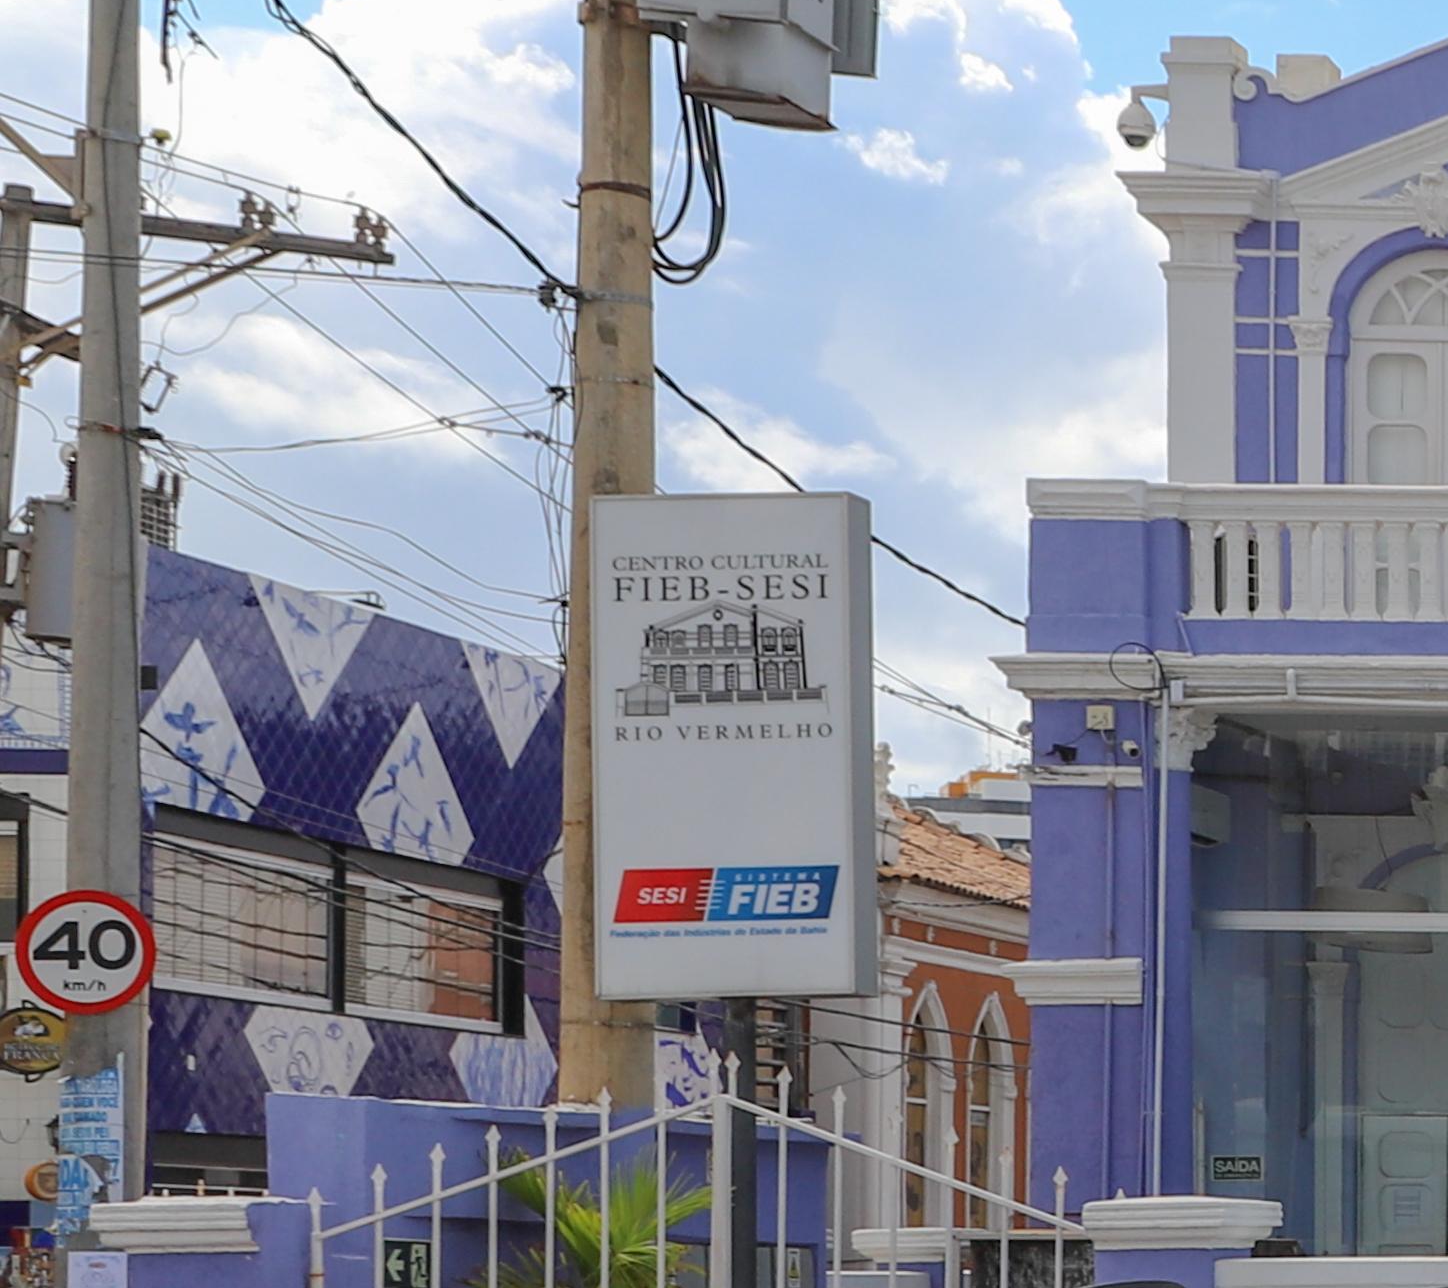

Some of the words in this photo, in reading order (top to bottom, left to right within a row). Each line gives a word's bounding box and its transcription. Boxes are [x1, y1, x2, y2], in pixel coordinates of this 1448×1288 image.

[612, 555, 704, 571] CENTRO
[711, 553, 829, 570] CULTURAL
[612, 573, 829, 602] FIEB-SESI
[615, 725, 663, 741] RIO
[676, 723, 833, 740] VERMELHO
[734, 872, 821, 882] SISTEMA
[636, 887, 687, 905] SESI
[727, 883, 821, 915] FIEB
[33, 919, 136, 970] 40
[63, 980, 106, 991] km/h
[1215, 1157, 1260, 1173] SAÍDA
